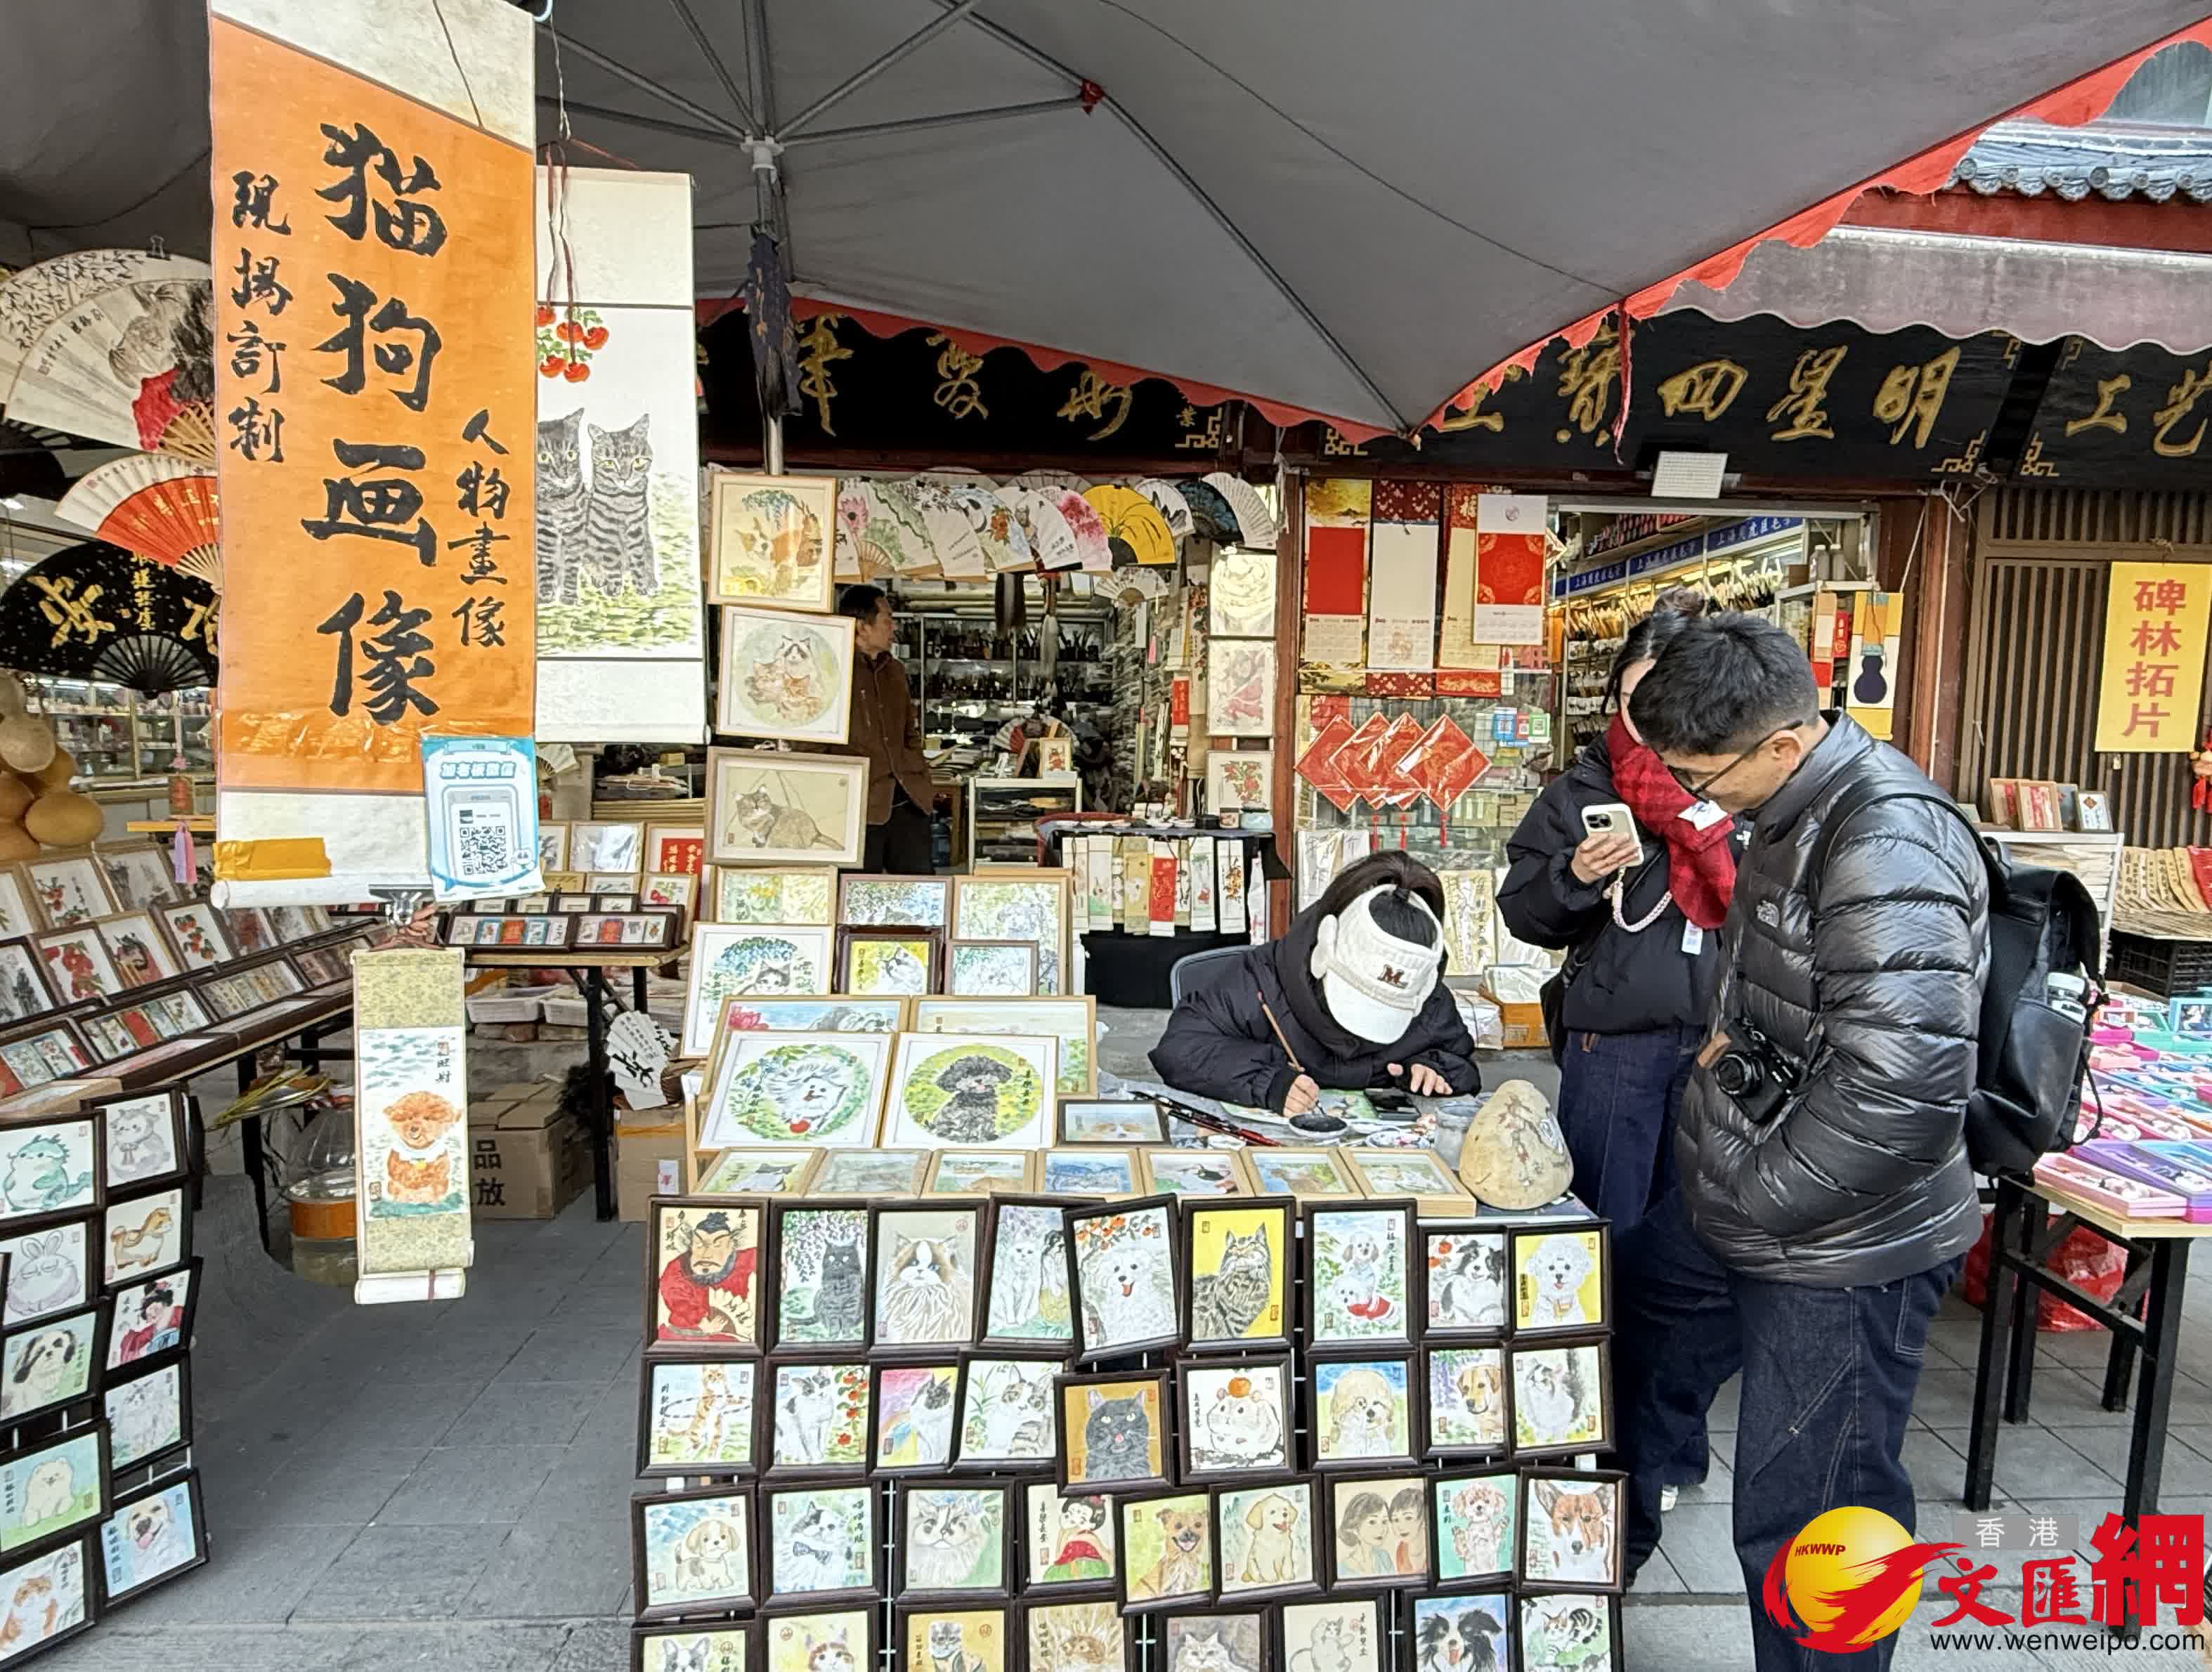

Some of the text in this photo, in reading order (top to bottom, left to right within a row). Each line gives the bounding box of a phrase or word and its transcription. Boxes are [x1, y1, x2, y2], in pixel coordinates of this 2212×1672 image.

[2122, 578, 2187, 739] 碑林拓片
[474, 1139, 502, 1170] 品
[476, 1177, 506, 1206] 放
